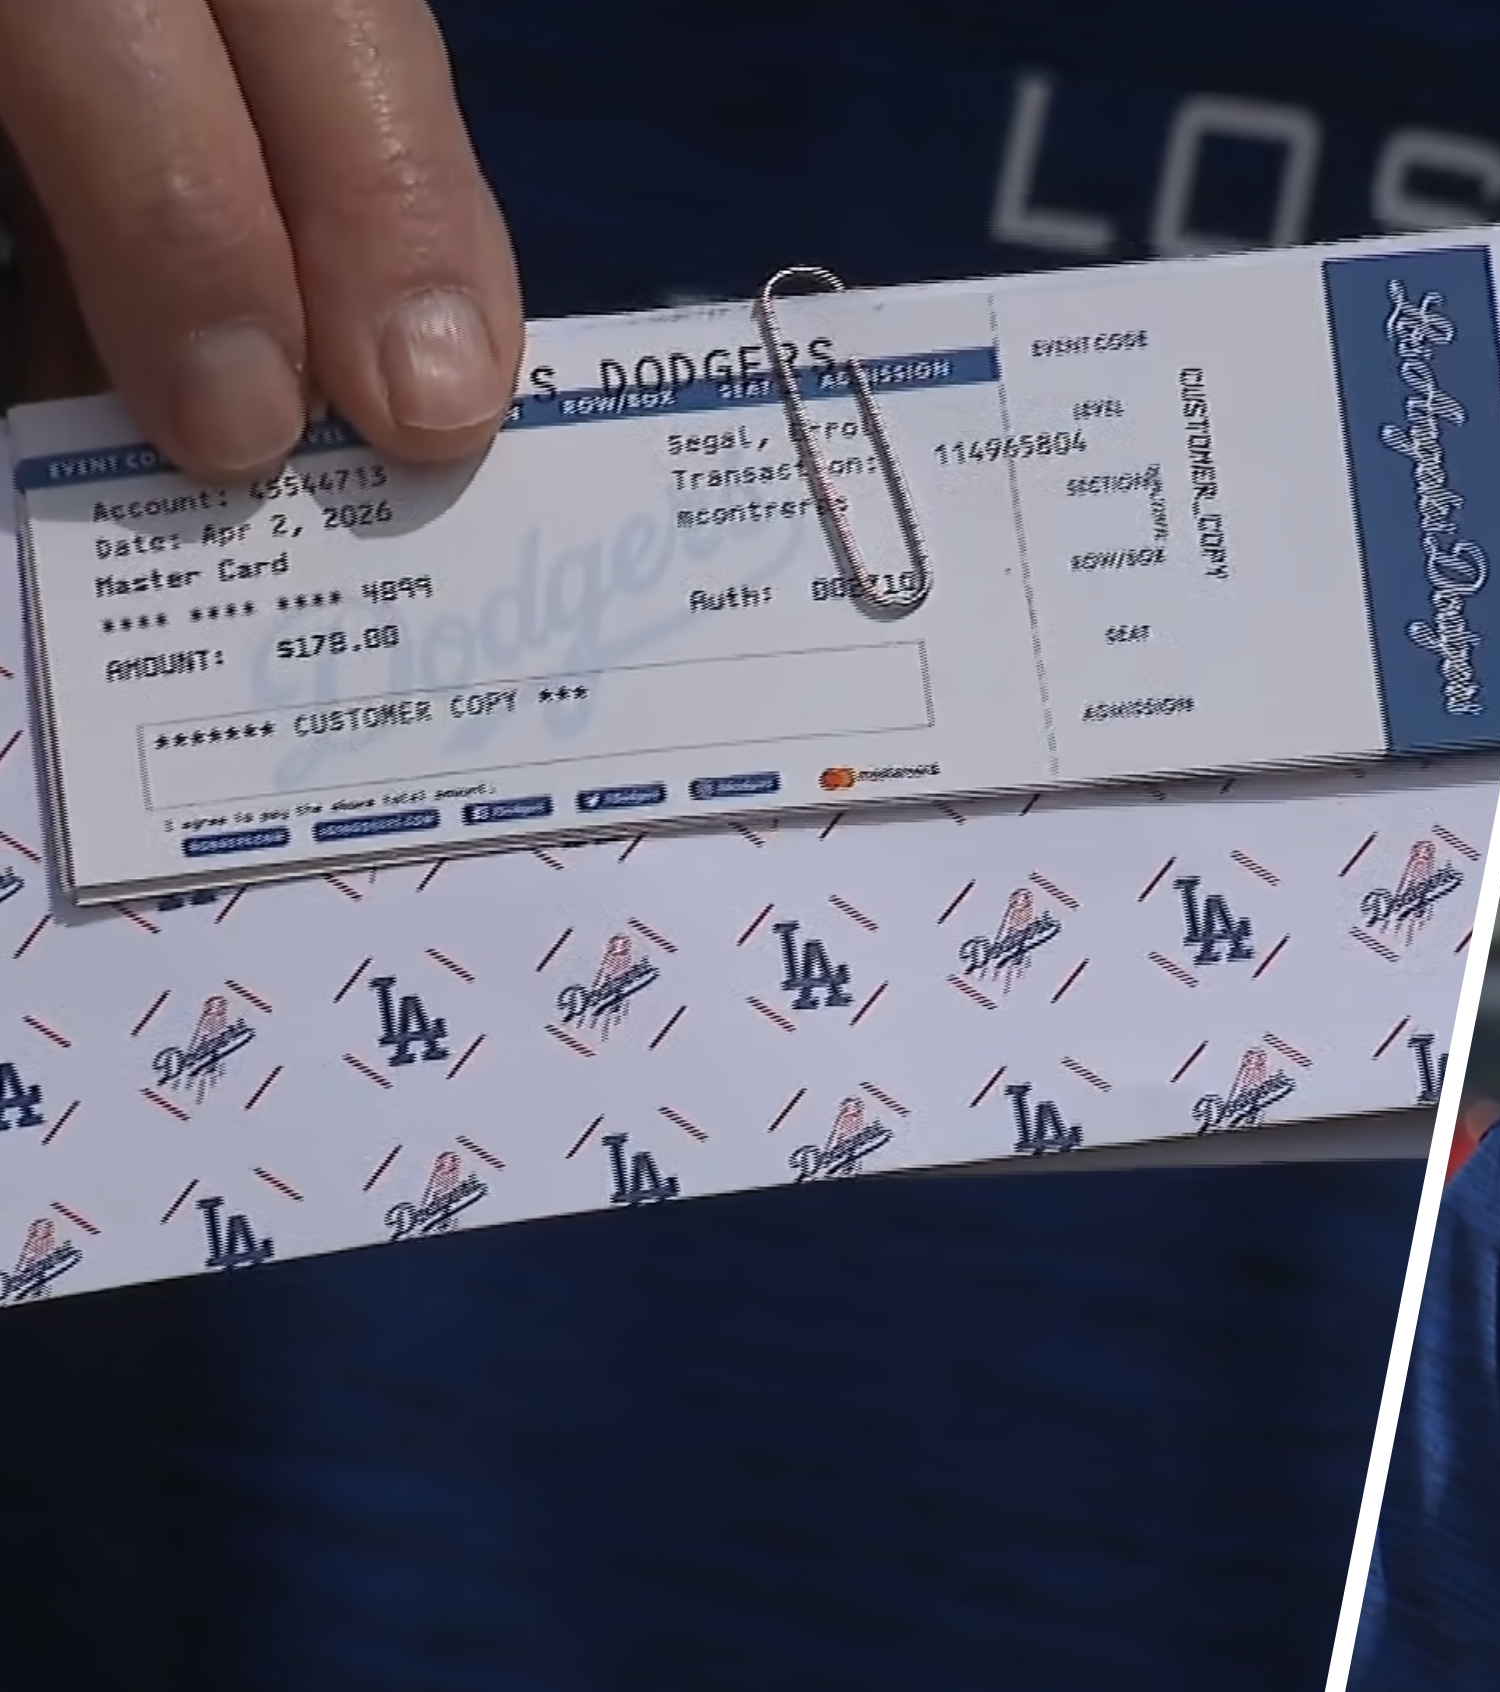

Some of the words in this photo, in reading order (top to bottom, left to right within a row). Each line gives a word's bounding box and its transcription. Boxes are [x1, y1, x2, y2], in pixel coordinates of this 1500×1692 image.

[600, 337, 837, 396] DODGERS
[1030, 335, 1091, 358] EVENT
[1092, 330, 1149, 353] CODE
[1072, 400, 1125, 420] LEVEL
[670, 456, 878, 491] Transacton:
[934, 428, 1088, 465] 114965804
[93, 489, 227, 522] Account:
[250, 464, 387, 500] 45544713
[95, 533, 181, 560] Date:
[202, 523, 251, 547] Apr
[270, 513, 303, 539] 2,
[323, 500, 394, 528] 2026
[96, 565, 202, 598] Master
[218, 552, 290, 582] Card
[688, 582, 773, 614] Auth:
[106, 649, 224, 683] AMOUNT:
[275, 624, 400, 659] $178.00
[1105, 625, 1151, 645] SEAT
[294, 699, 433, 738] CUSTOMER
[450, 687, 519, 718] COPY
[1082, 694, 1196, 722] ADMISSION
[1172, 875, 1254, 966] LA
[771, 920, 854, 1010] LA
[368, 976, 452, 1067] LA
[0, 1062, 44, 1130] A
[1004, 1082, 1083, 1156] LA
[601, 1132, 680, 1205] LA
[196, 1196, 275, 1268] LA
